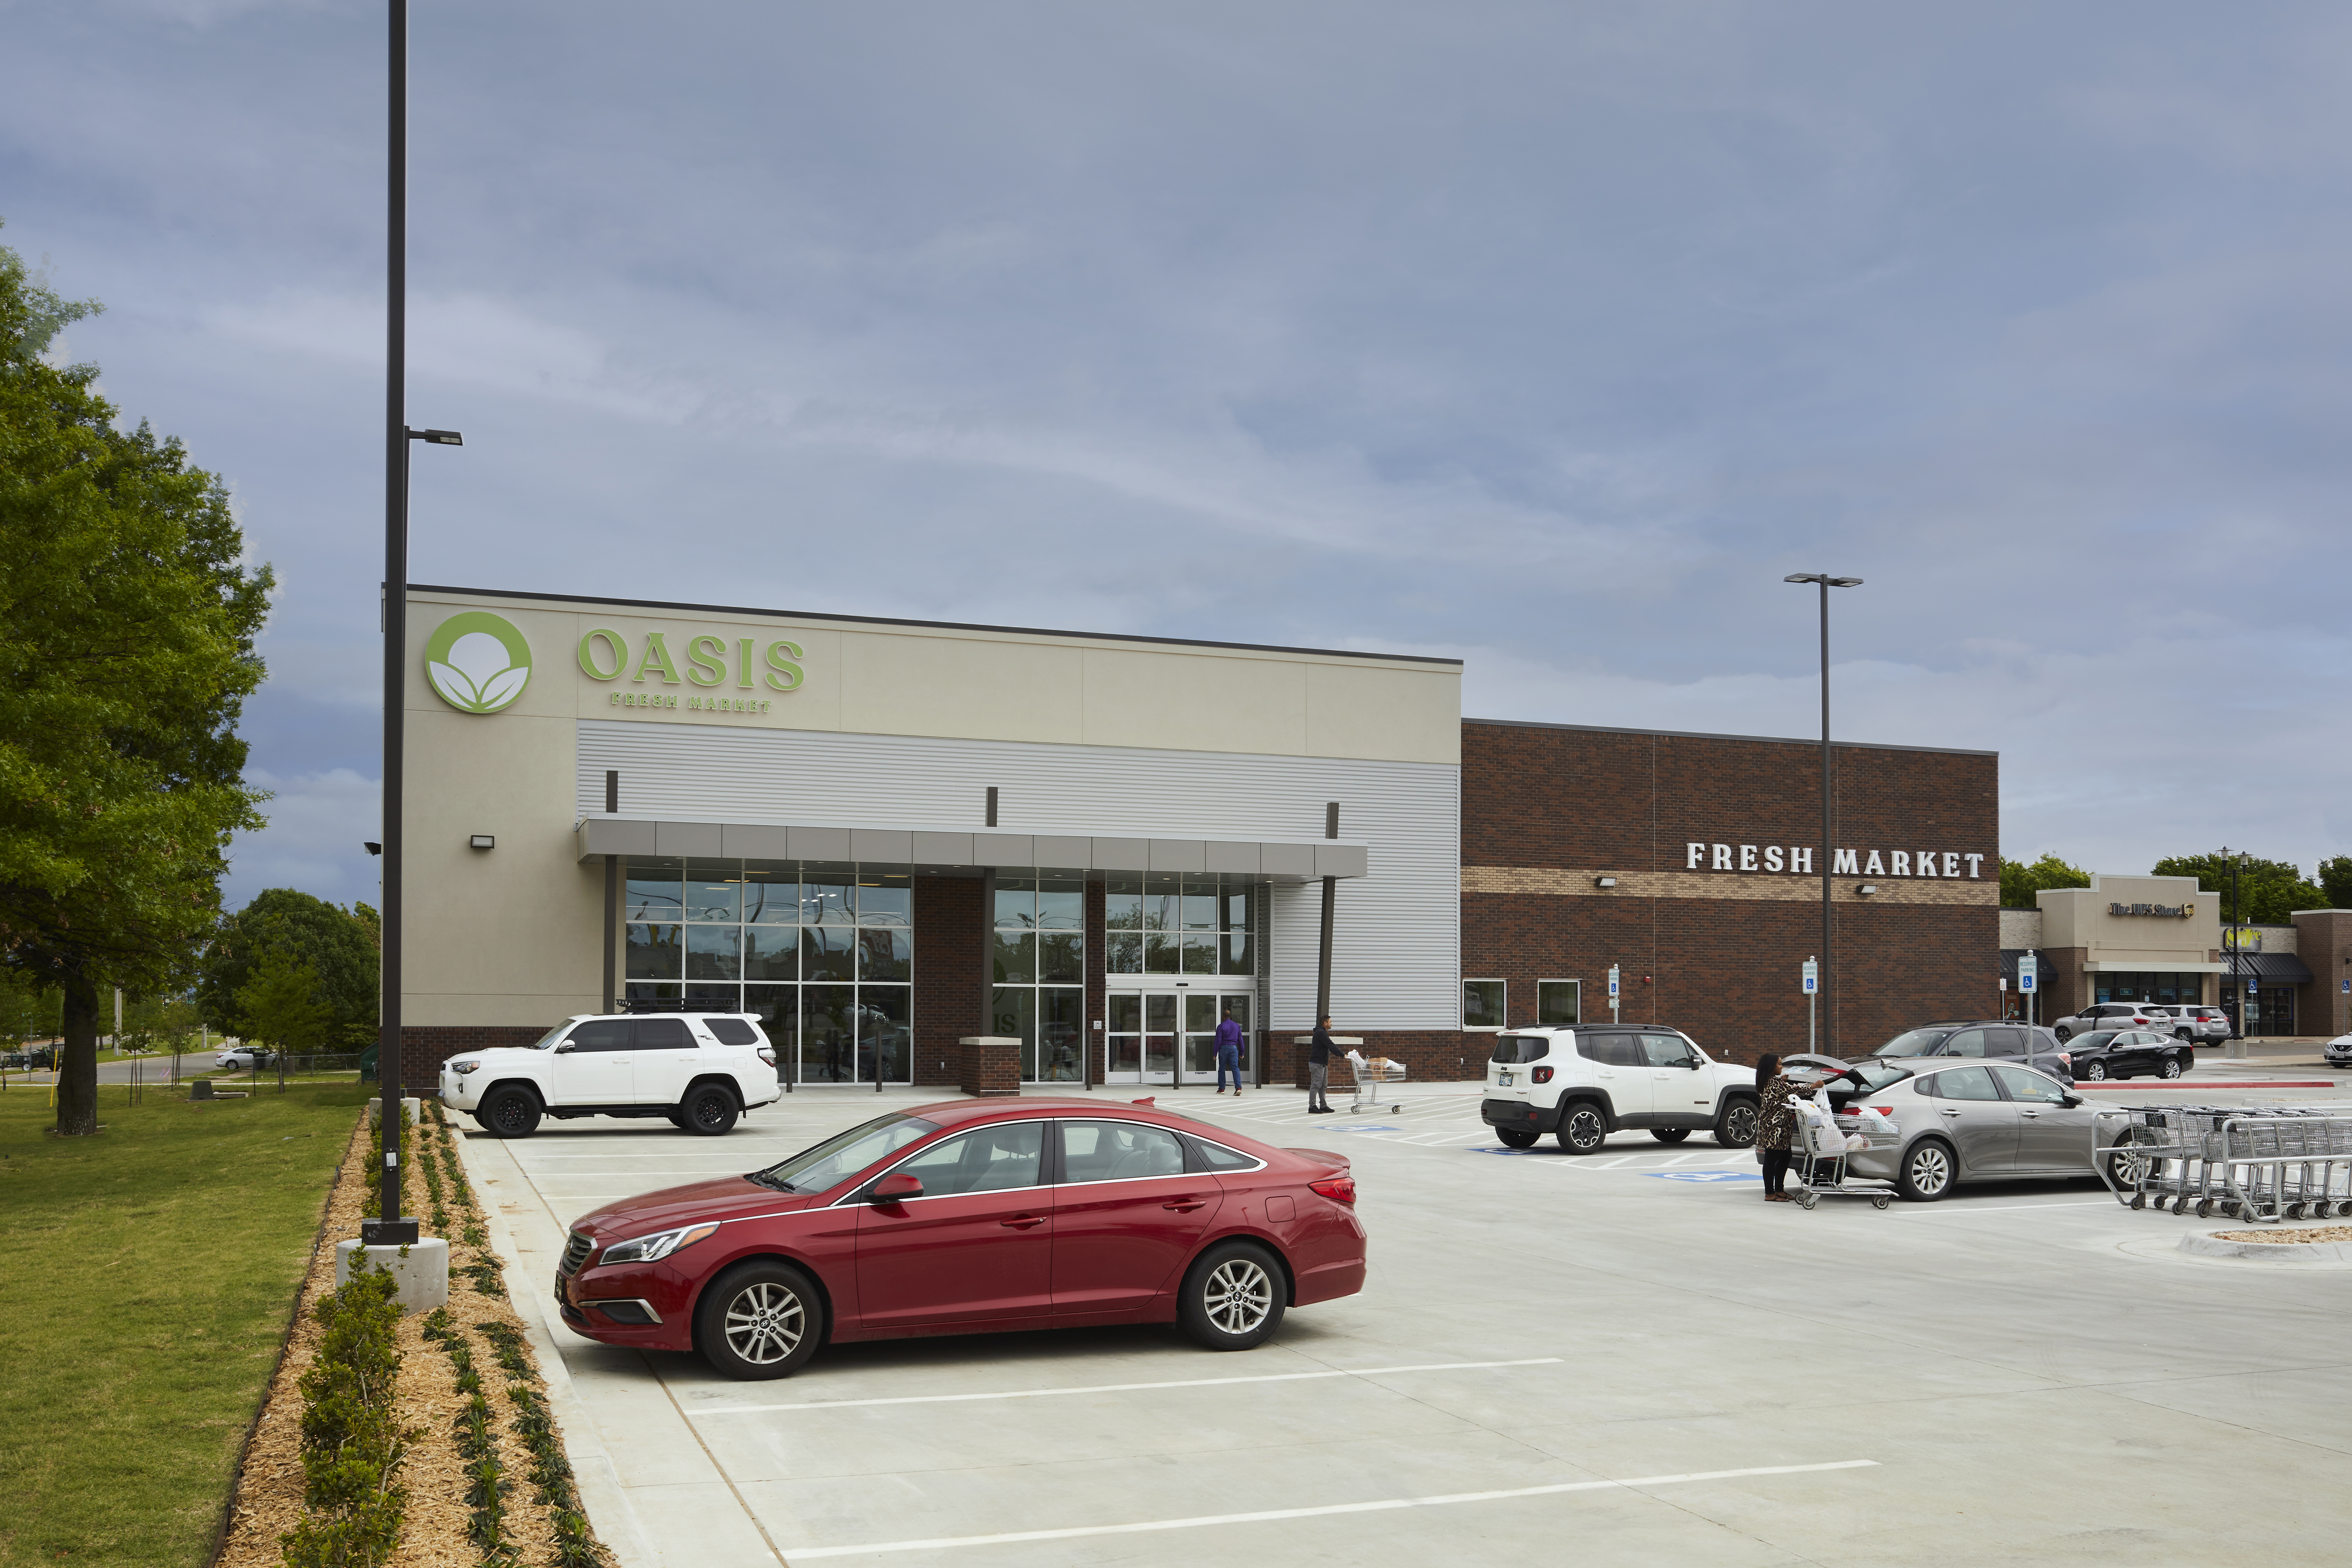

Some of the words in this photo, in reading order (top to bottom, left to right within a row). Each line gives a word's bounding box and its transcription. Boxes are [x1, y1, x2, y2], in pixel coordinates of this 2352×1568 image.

[578, 628, 804, 690] OASIS
[612, 691, 678, 709] FRESH
[689, 696, 771, 712] MARKET
[1686, 843, 1812, 873] FRESH
[1832, 849, 1983, 878] MARKET
[2110, 903, 2130, 914] The
[2132, 903, 2153, 915] UPS
[2155, 904, 2181, 916] Store
[2185, 907, 2193, 916] ups
